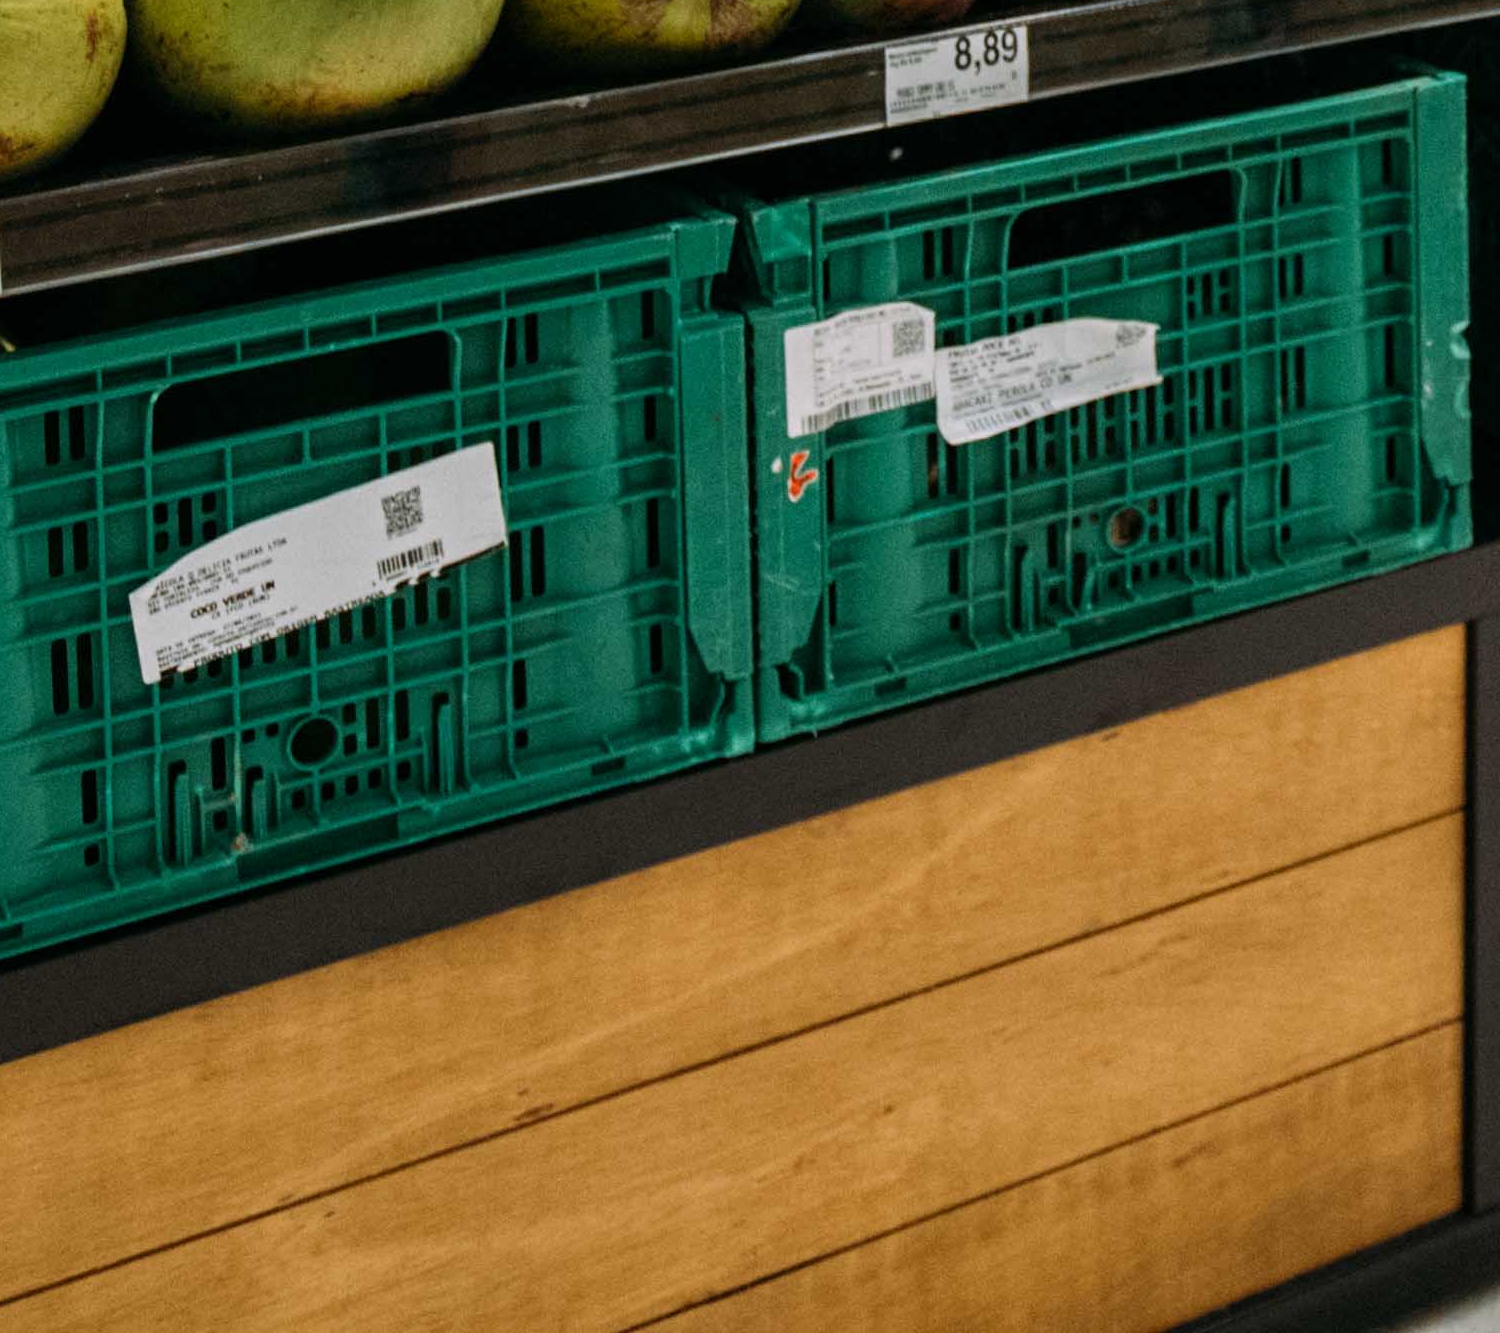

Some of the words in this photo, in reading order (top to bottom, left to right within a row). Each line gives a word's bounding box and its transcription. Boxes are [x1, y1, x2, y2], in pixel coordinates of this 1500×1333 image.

[955, 26, 1018, 75] 8,89
[190, 602, 218, 619] COCO
[222, 587, 255, 606] VERDE
